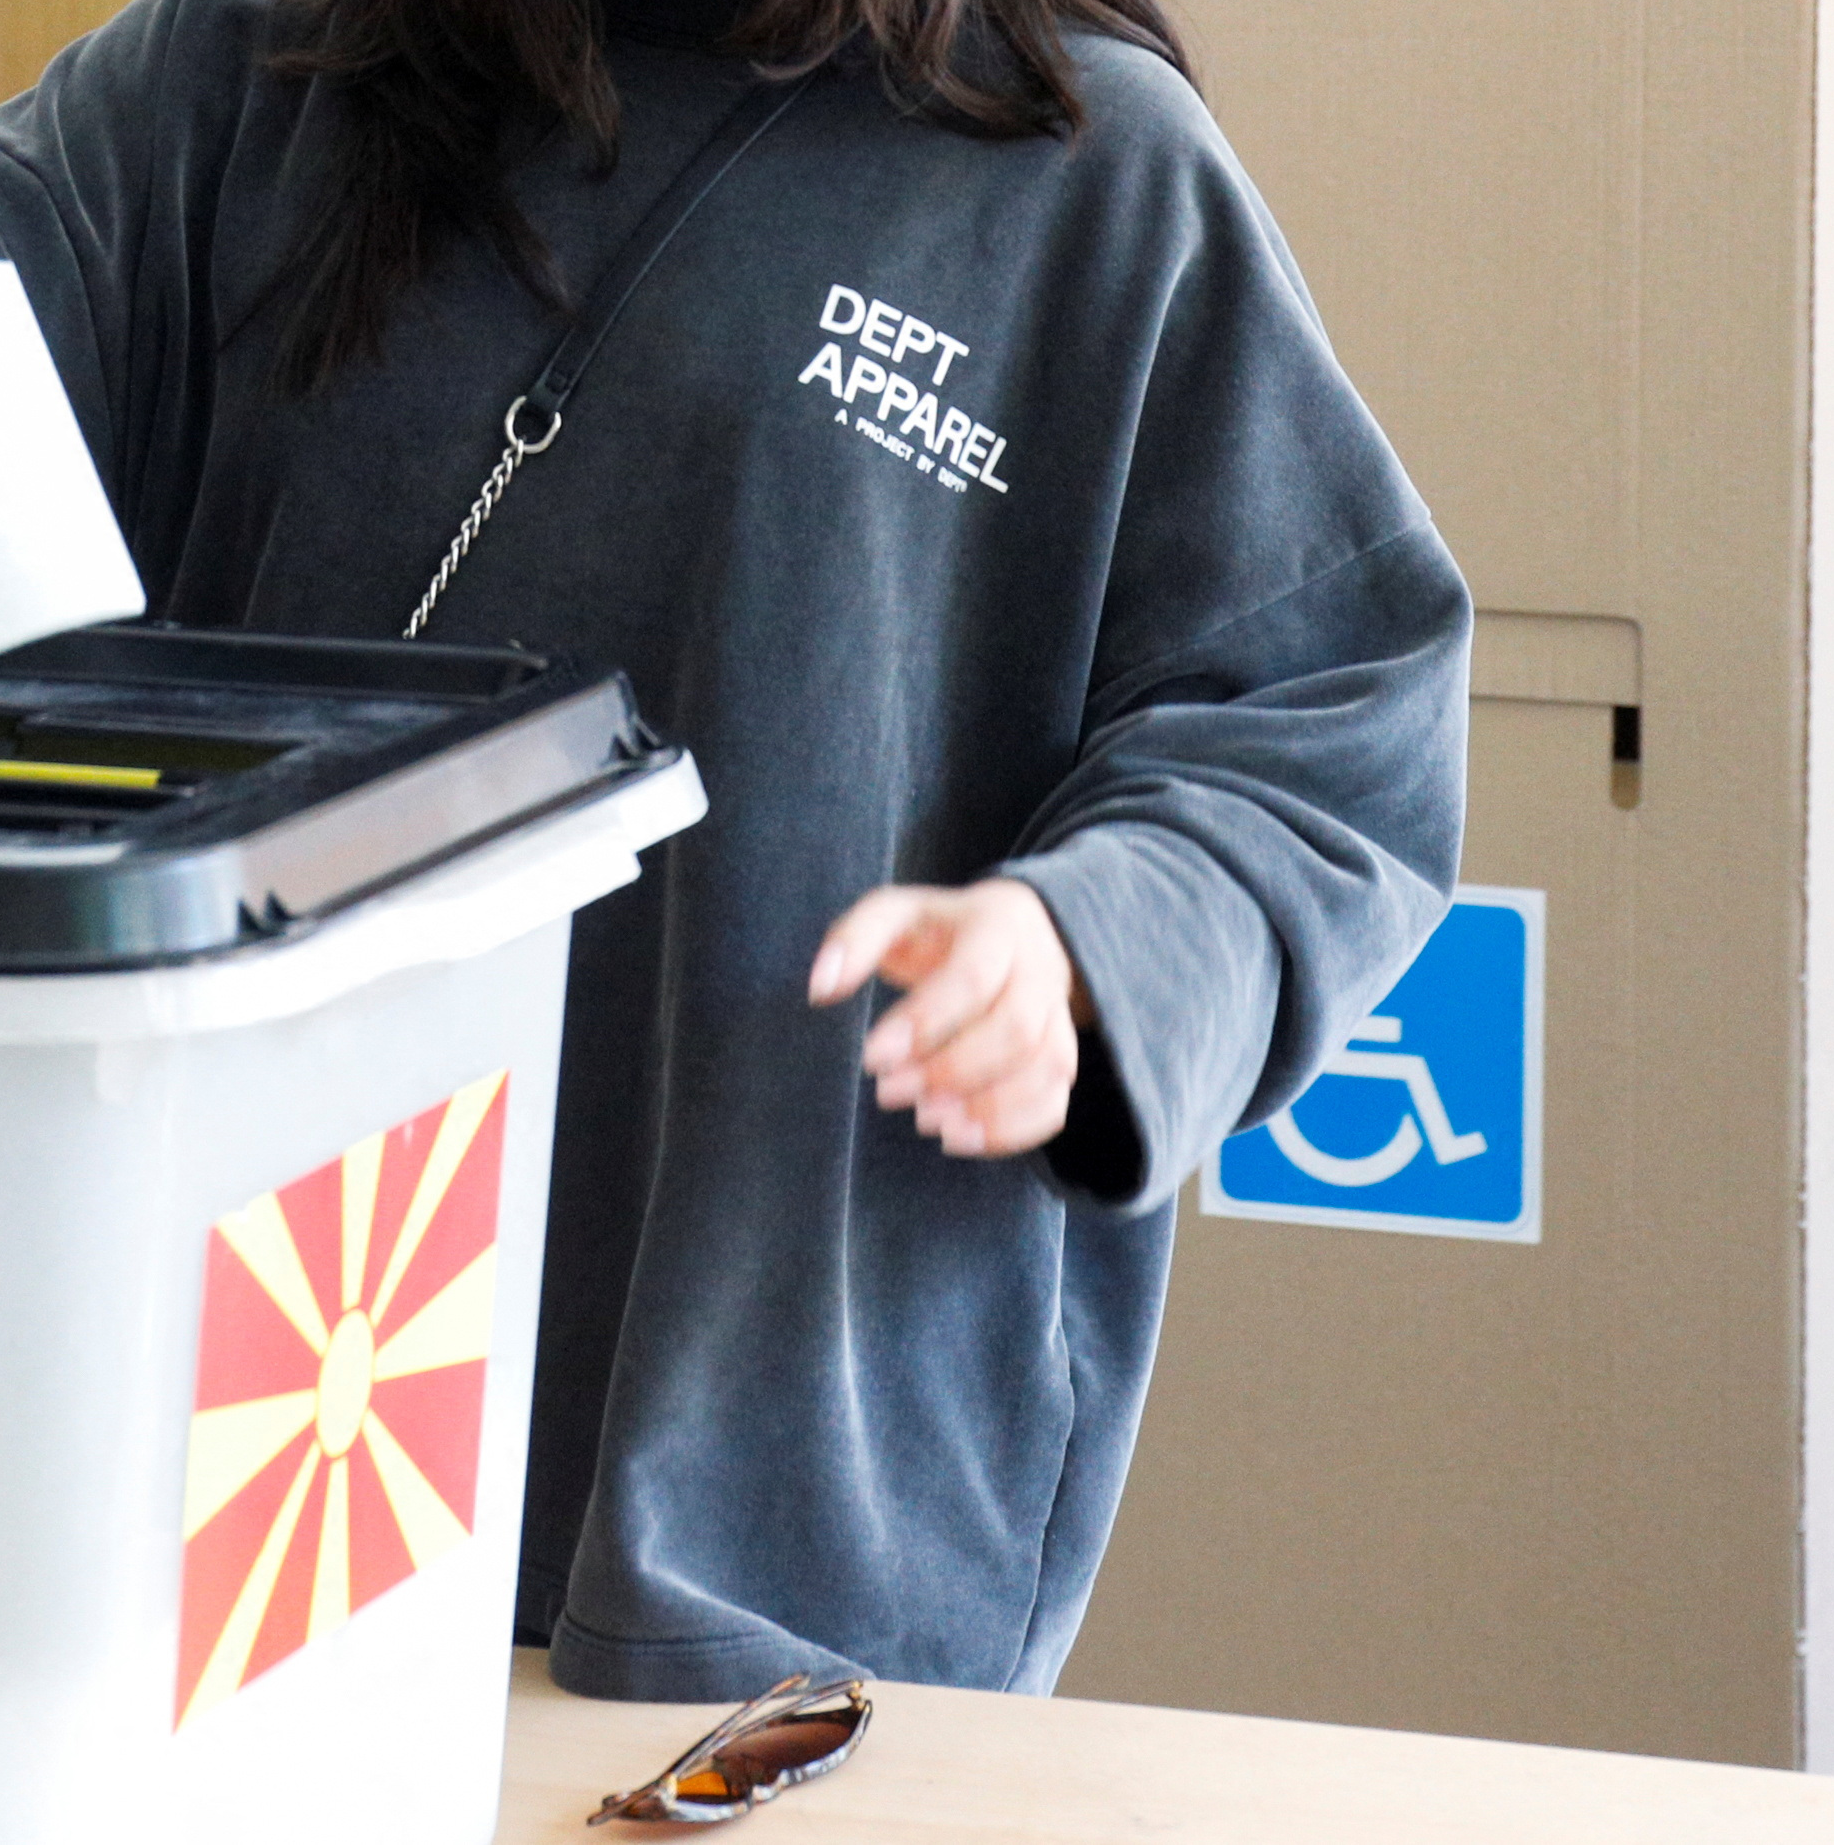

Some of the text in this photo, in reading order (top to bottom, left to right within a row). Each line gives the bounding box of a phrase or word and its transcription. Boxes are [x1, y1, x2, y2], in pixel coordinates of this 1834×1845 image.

[819, 283, 970, 386] DEPT
[798, 342, 1009, 493] APPAREL
[834, 408, 848, 425] A
[855, 416, 915, 461] PROJECT
[916, 454, 935, 474] BY
